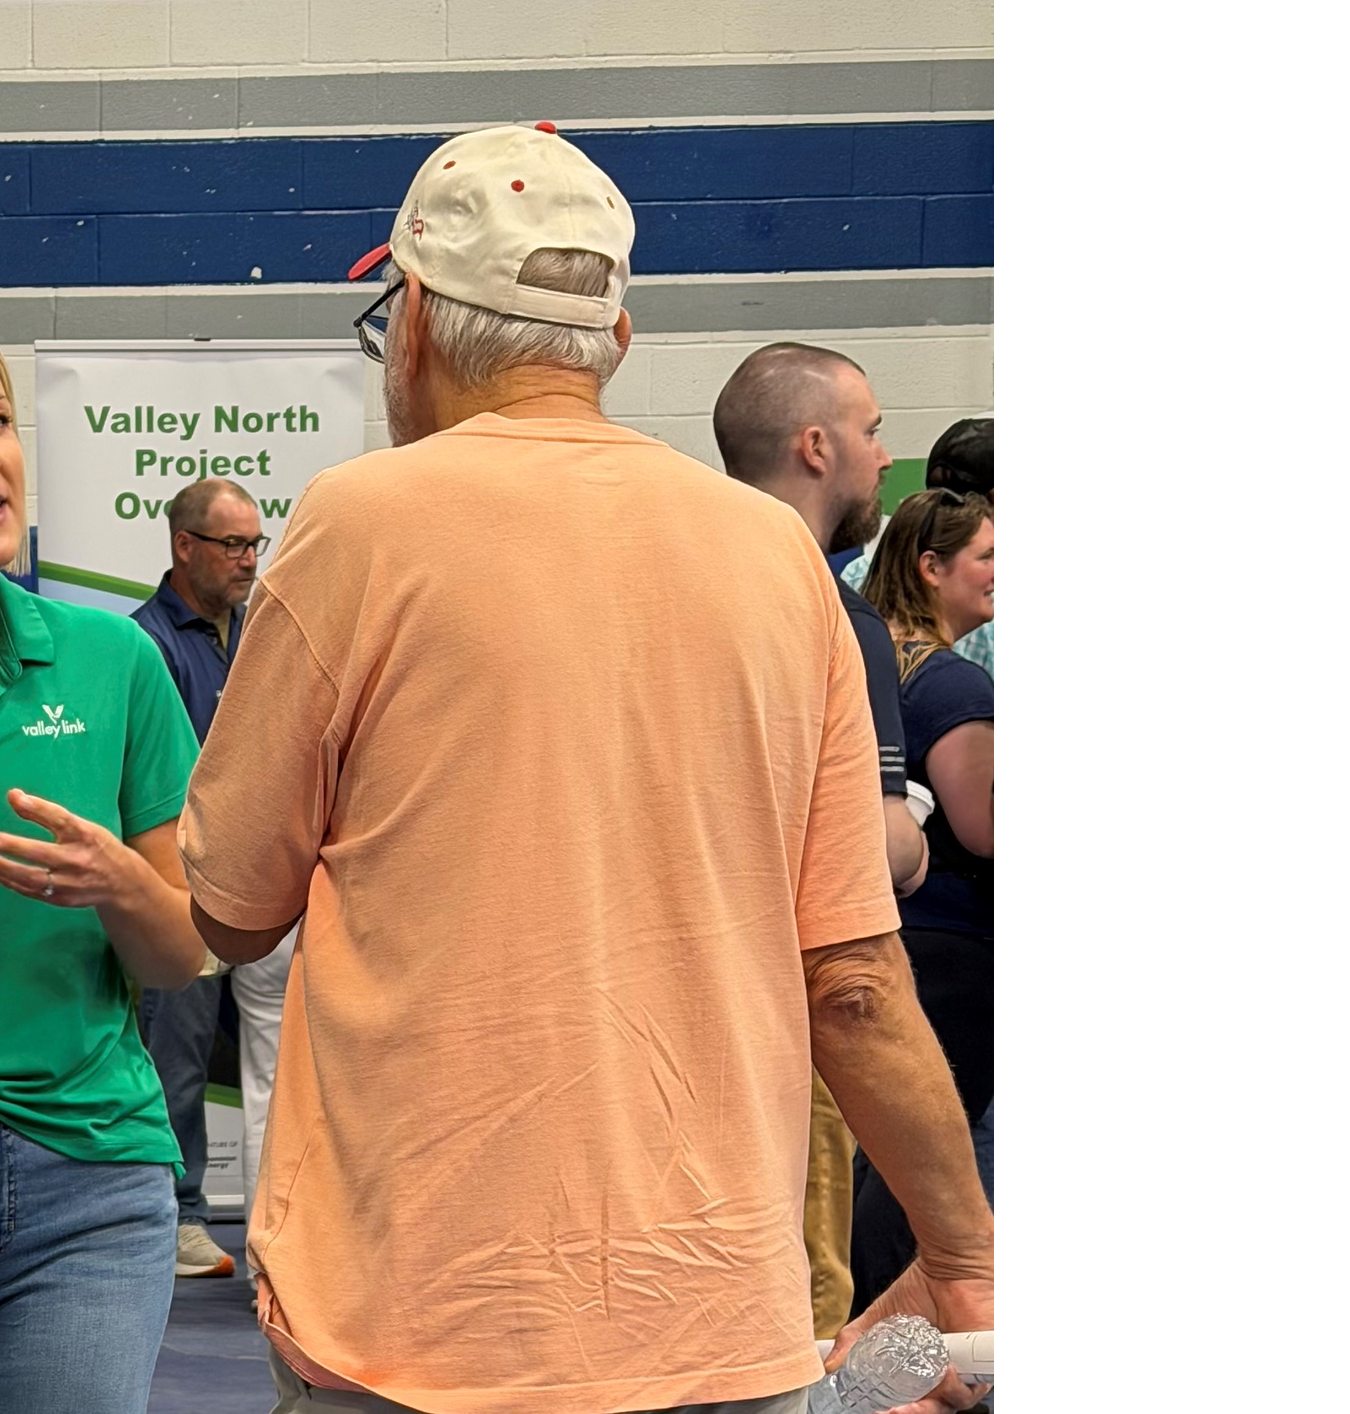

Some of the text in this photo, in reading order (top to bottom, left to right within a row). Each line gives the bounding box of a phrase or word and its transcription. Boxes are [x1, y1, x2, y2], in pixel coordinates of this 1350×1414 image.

[84, 405, 319, 441] Valley North
[135, 449, 271, 482] Project
[22, 718, 86, 739] valley link
